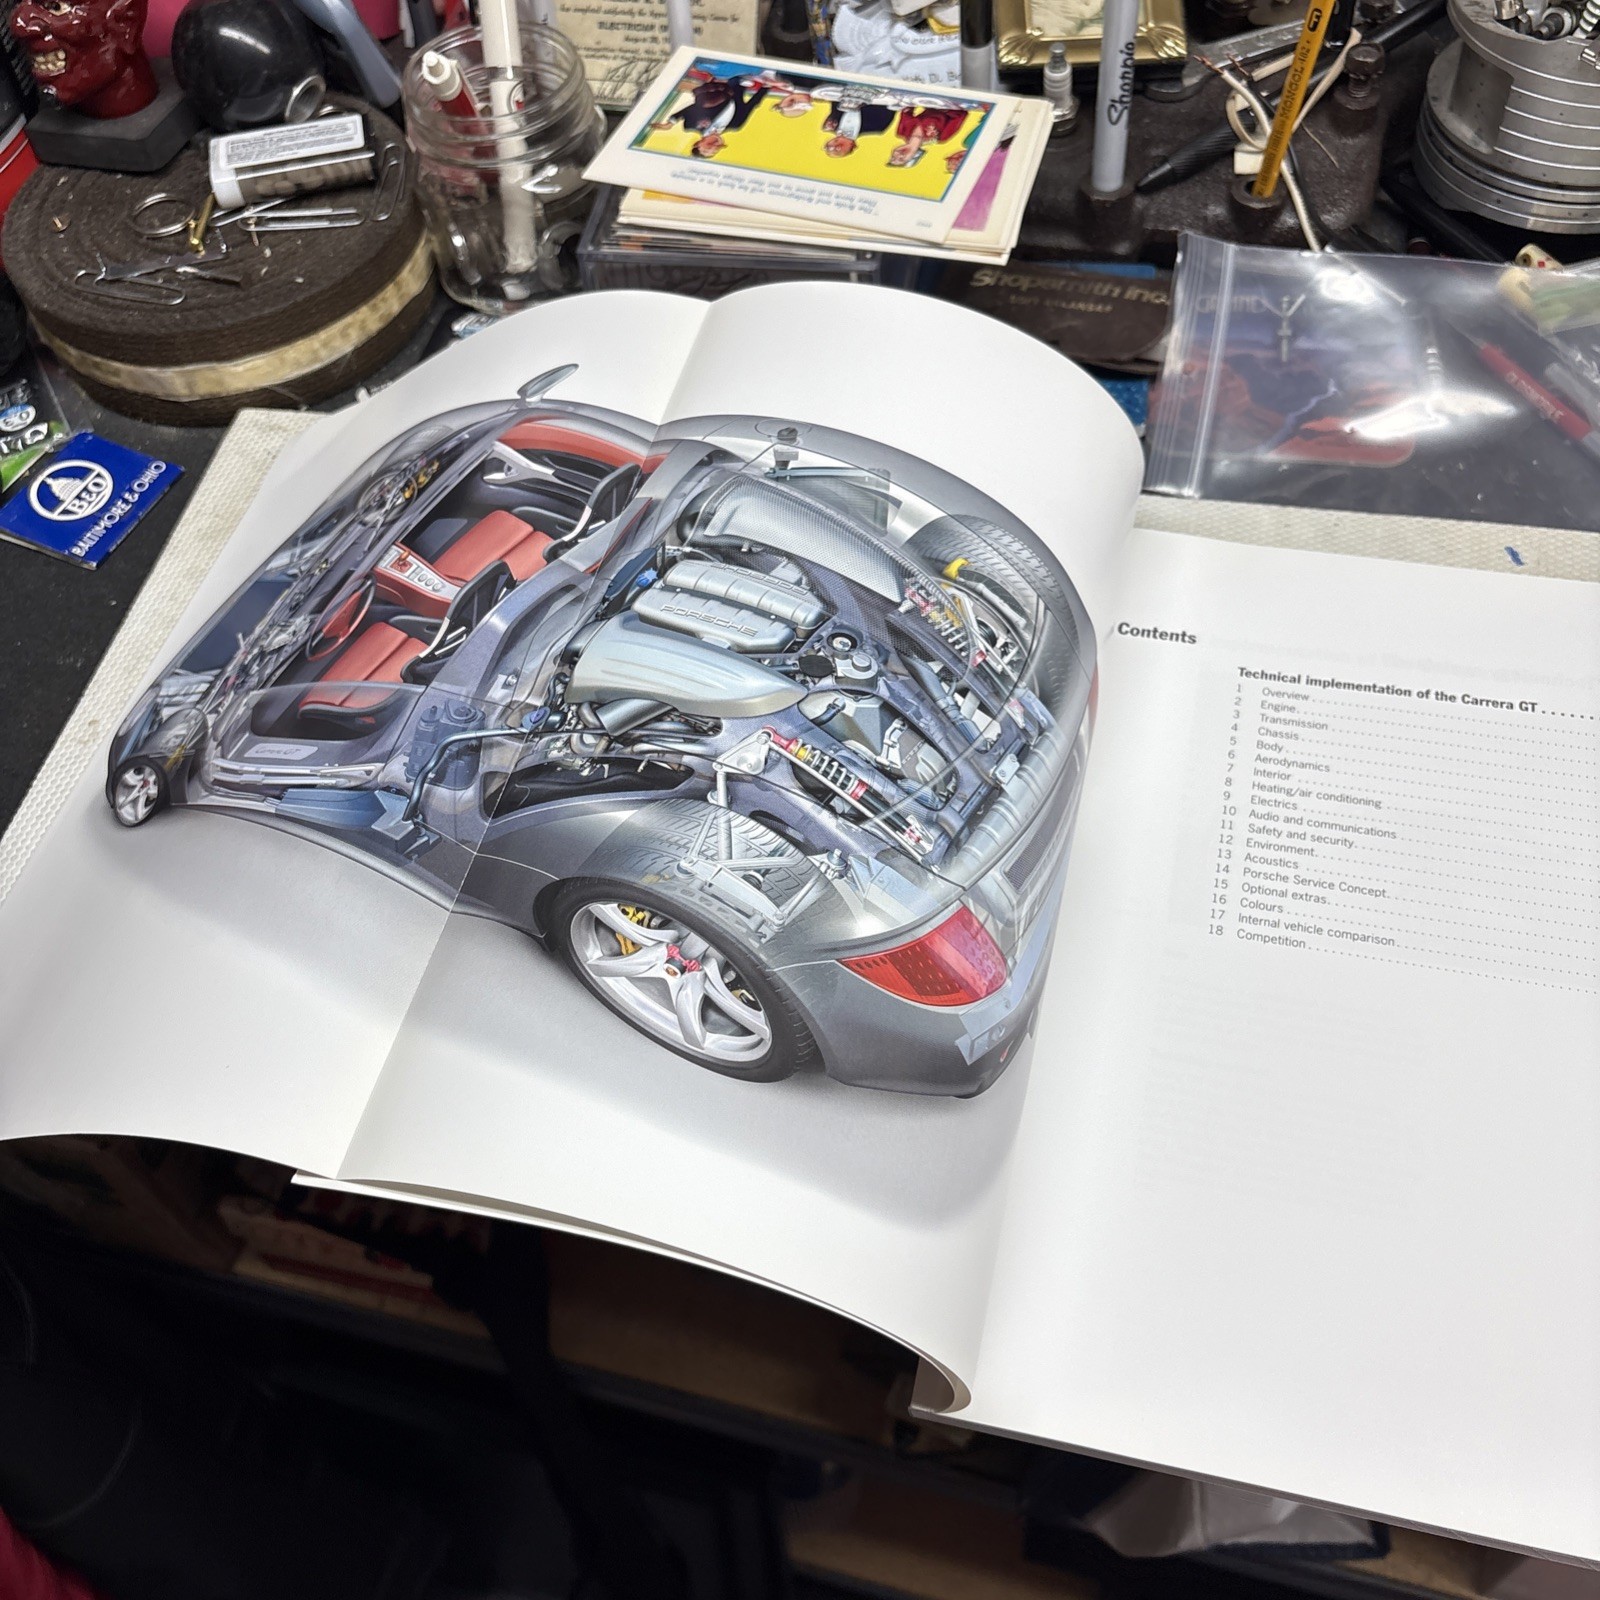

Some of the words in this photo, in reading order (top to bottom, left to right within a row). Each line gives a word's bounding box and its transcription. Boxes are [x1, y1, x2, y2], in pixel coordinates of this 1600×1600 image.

[1107, 42, 1135, 126] Sharpie
[1280, 67, 1305, 120] MONGOL
[70, 499, 132, 558] BALTIMORE
[130, 460, 166, 493] OHIO
[660, 603, 758, 638] PORSCHE
[1117, 622, 1197, 645] Contents
[1236, 684, 1241, 693] 1
[1262, 687, 1310, 702] Overview
[1238, 666, 1302, 685] Technical
[1305, 675, 1412, 698] implementation
[1416, 688, 1431, 701] of
[1434, 690, 1457, 704] the
[1461, 693, 1514, 711] Carrera
[1518, 700, 1538, 714] GT
[1234, 697, 1242, 706] 2
[1260, 700, 1296, 714] Engine
[1231, 723, 1238, 732] 4
[1258, 726, 1299, 741] Chassis
[1232, 710, 1240, 719] 3
[1260, 713, 1328, 731] Transmission
[1229, 736, 1237, 746] 5
[1256, 740, 1284, 755] Body
[1227, 750, 1235, 759] 6
[1254, 753, 1330, 773] Aerodynamics
[1227, 763, 1234, 773] 7
[1253, 767, 1292, 781] Interior
[1223, 791, 1231, 801] 9
[1250, 794, 1298, 811] Electrics
[1224, 777, 1232, 787] 8
[1252, 781, 1312, 798] Heating/air
[1316, 790, 1382, 810] conditioning
[1222, 805, 1237, 817] 10
[1248, 808, 1280, 823] Audio
[1283, 814, 1303, 827] and
[1306, 819, 1397, 840] communications
[1219, 834, 1233, 846] 12
[1246, 837, 1315, 857] Environment
[1220, 820, 1233, 831] 11
[1247, 823, 1283, 839] Safety
[1286, 829, 1307, 841] and
[1310, 833, 1354, 850] security
[1217, 848, 1232, 860] 13
[1244, 852, 1299, 870] Acoustics
[1214, 878, 1229, 890] 15
[1241, 882, 1288, 899] Optional
[1291, 891, 1327, 905] extras
[1215, 863, 1230, 875] 14
[1243, 867, 1289, 884] Porsche
[1293, 874, 1335, 891] Service
[1338, 881, 1387, 899] Concept
[1212, 893, 1227, 905] 16
[1240, 897, 1284, 914] Colours
[1208, 924, 1224, 936] 18
[1236, 928, 1306, 949] Competition
[1210, 908, 1226, 920] 17
[1238, 913, 1280, 929] Internal
[1284, 919, 1324, 936] vehicle
[1327, 927, 1396, 947] comparison
